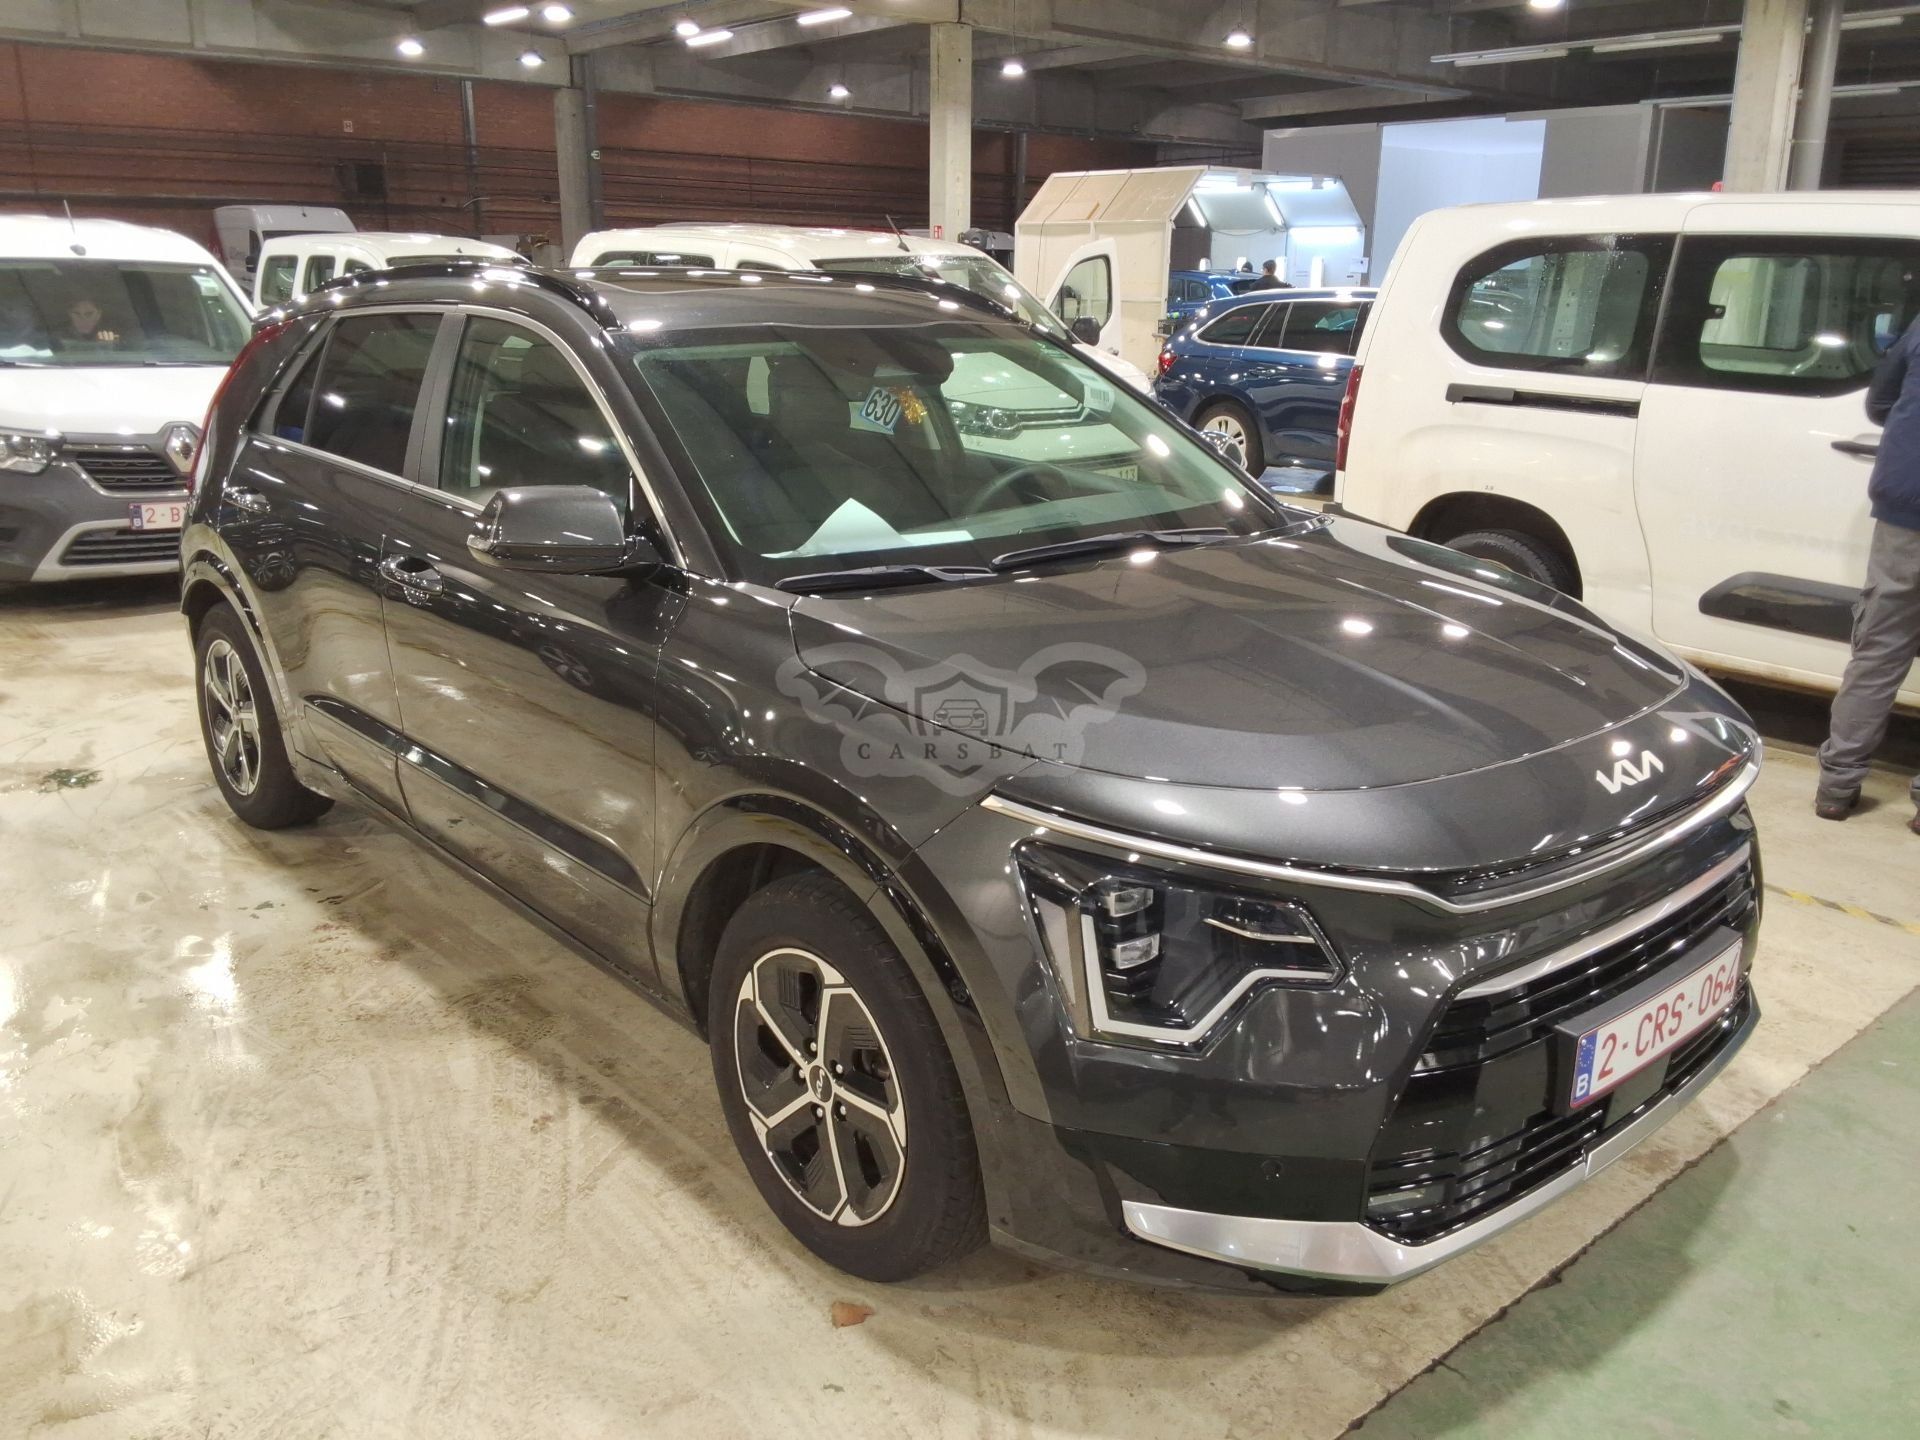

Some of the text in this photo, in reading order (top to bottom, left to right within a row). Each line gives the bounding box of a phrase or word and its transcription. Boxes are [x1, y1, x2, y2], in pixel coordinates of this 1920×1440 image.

[865, 389, 899, 426] 630
[1596, 750, 1664, 794] KIA
[1576, 952, 1739, 1097] B 2-CRS-064
